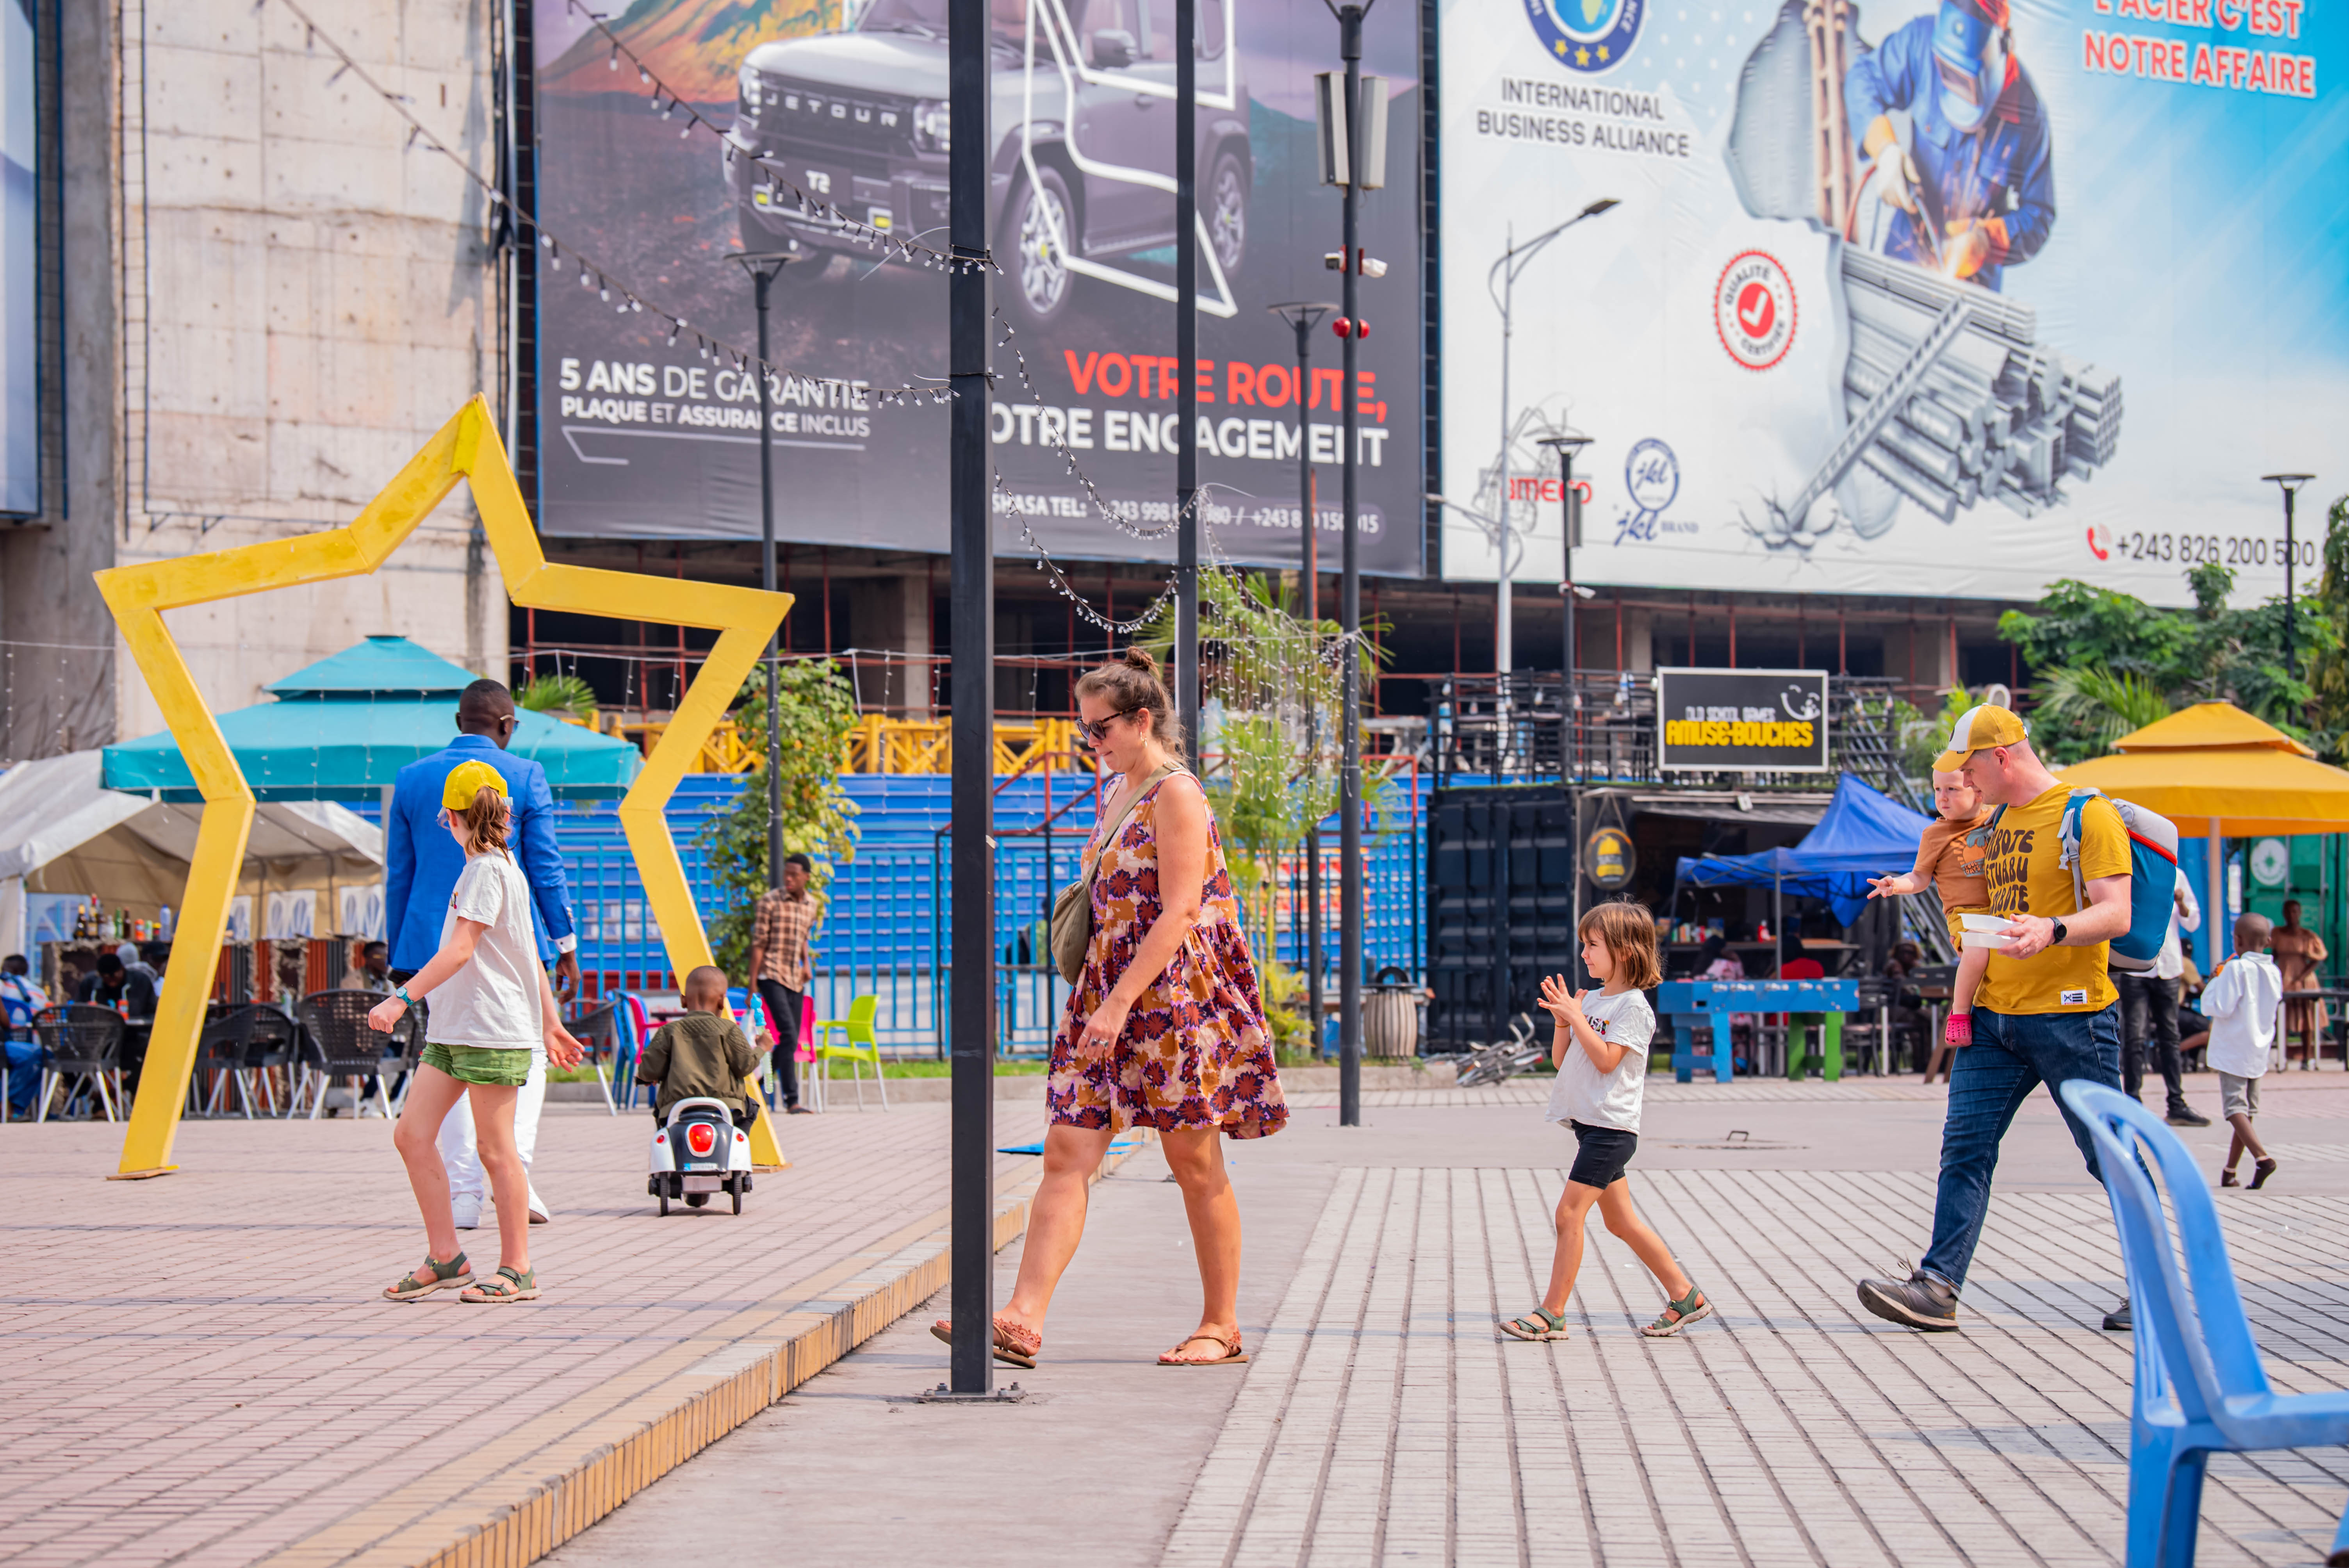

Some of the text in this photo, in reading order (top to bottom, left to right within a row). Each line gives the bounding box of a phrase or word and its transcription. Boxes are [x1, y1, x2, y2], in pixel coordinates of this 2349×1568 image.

[2085, 34, 2312, 93] NOTRE AFFAIRE
[765, 93, 898, 128] JETOUR
[1501, 77, 1665, 121] INTERNATIONAL
[1477, 110, 1689, 157] BUSINESS ALLIANCE
[805, 169, 831, 194] T2
[559, 357, 870, 412] 5 ANS DE GARANTIE
[1064, 349, 1387, 423] VOTRE ROUTE,
[560, 395, 648, 424] PLAQUE
[651, 402, 676, 424] ET
[801, 413, 871, 438] INCLUS
[992, 402, 1094, 449] OTRE
[1050, 496, 1087, 518] TEL:
[1141, 501, 1170, 522] 998
[2117, 531, 2315, 567] +243 826 200 500
